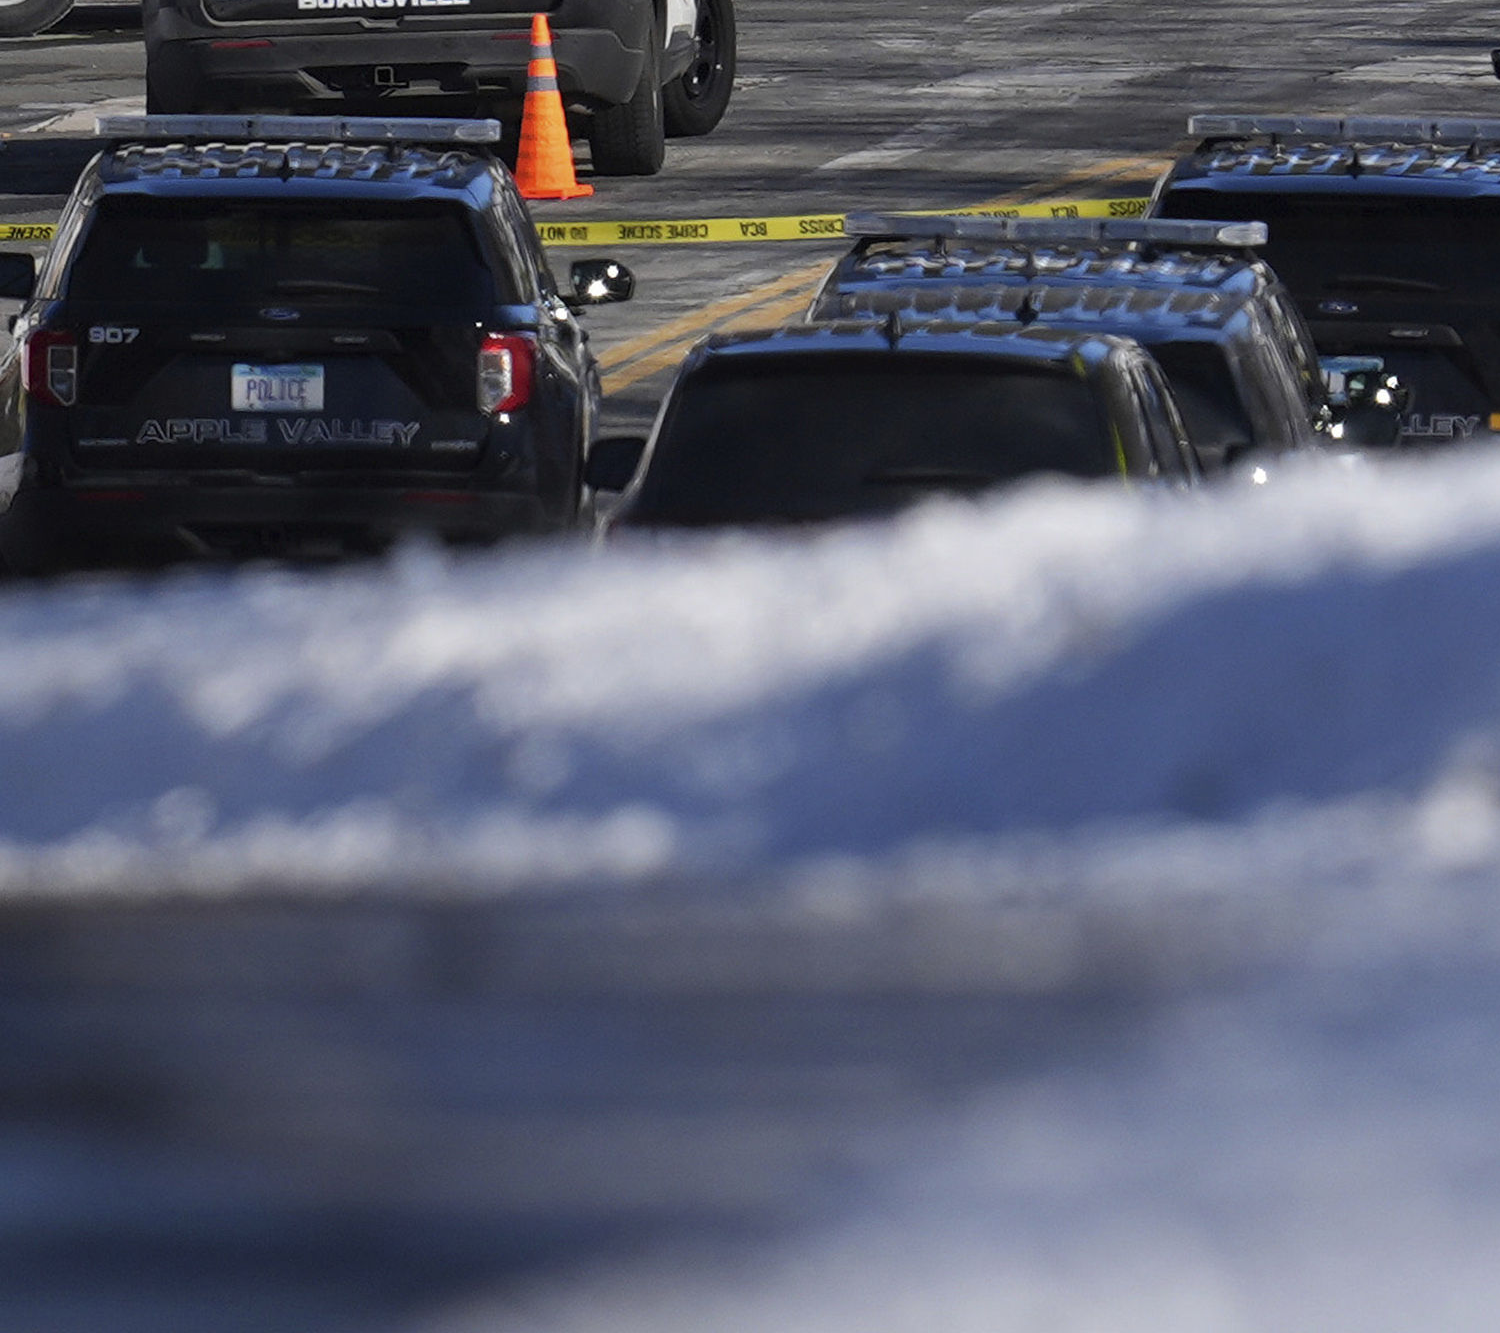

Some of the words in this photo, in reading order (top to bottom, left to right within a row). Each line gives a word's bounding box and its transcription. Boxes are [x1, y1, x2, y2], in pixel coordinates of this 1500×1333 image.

[1108, 199, 1150, 216] ROSS
[6, 225, 53, 240] SCENE
[569, 225, 588, 240] DO
[617, 224, 663, 240] SCENE
[667, 223, 709, 239] CRIME
[739, 220, 768, 237] BCA
[798, 218, 845, 235] CROSS
[246, 378, 309, 402] POLICE
[136, 419, 267, 444] APPLE
[278, 419, 421, 447] VALLEY
